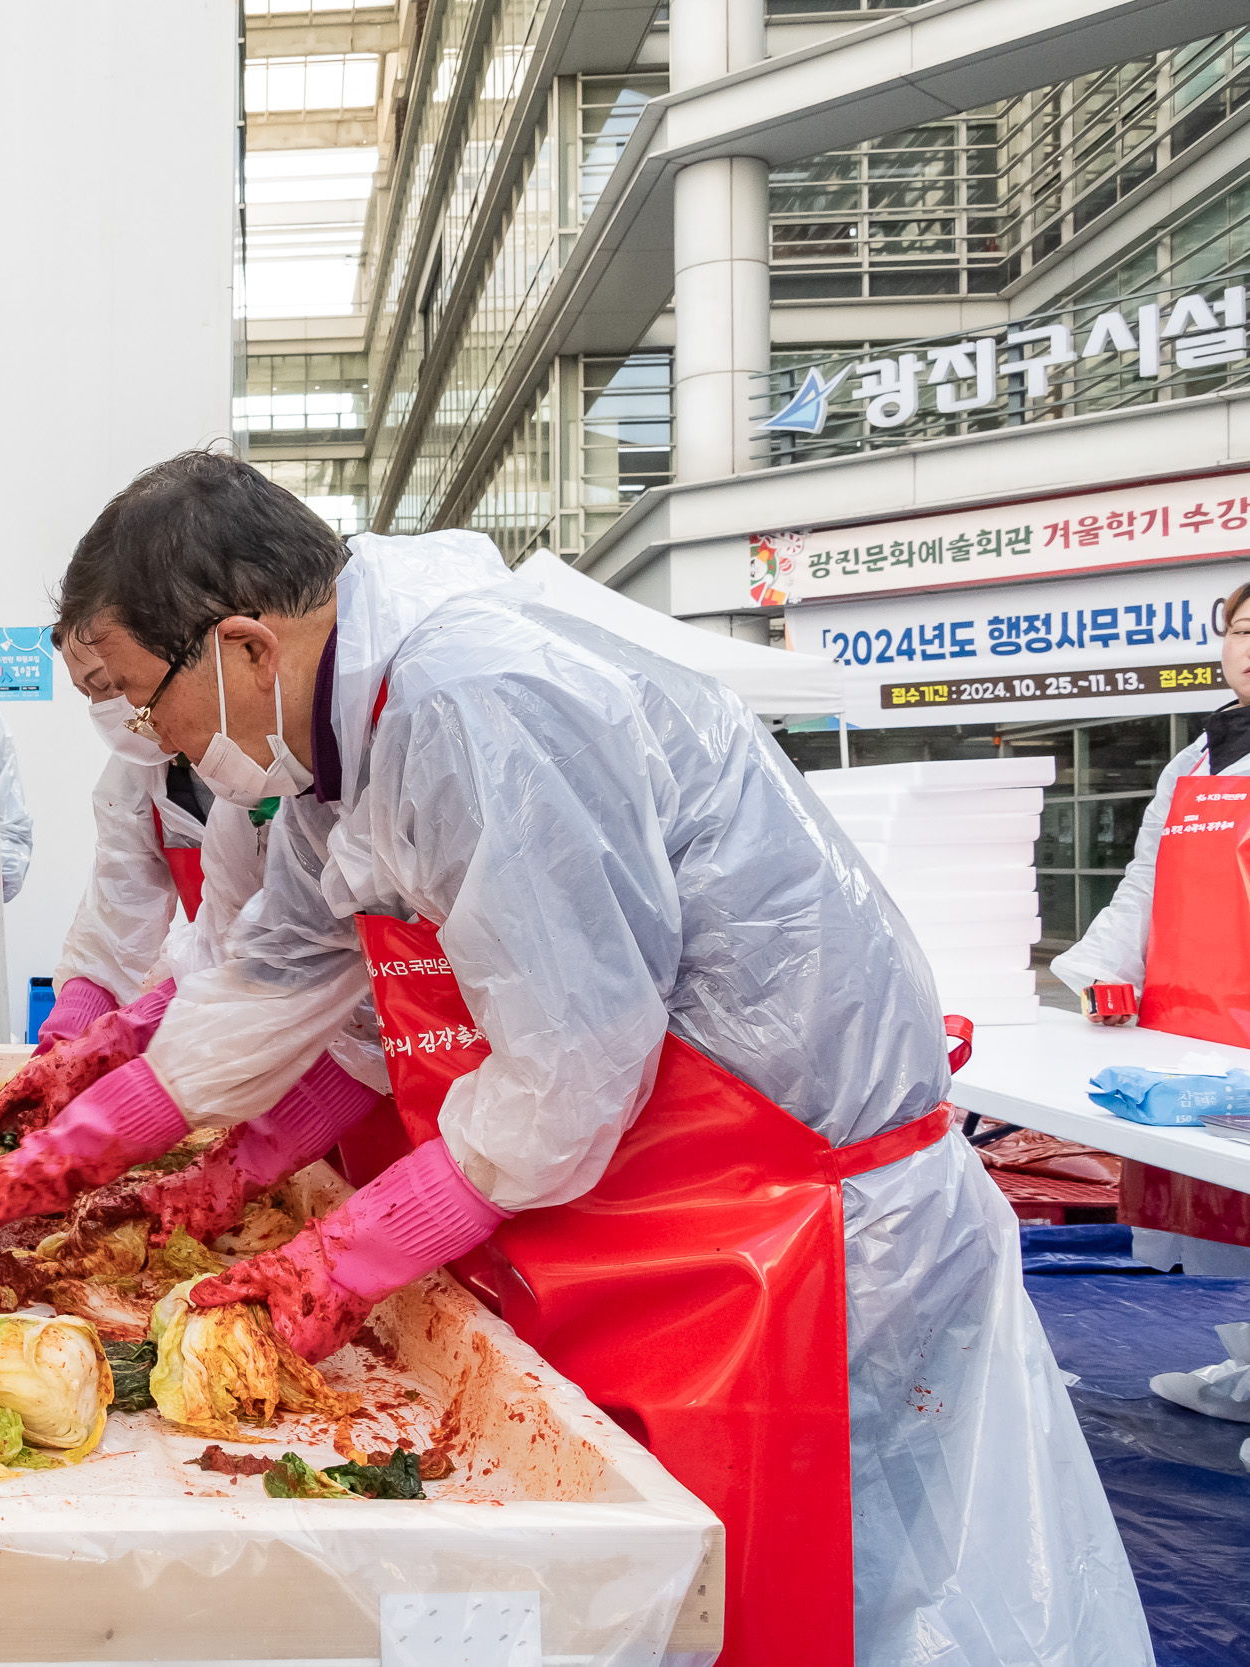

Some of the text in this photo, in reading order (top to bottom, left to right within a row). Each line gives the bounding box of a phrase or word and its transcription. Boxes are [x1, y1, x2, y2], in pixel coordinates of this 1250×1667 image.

[852, 285, 1247, 428] 광진구시설
[809, 496, 1250, 578] 광진문화예술회관 겨울학기 수강
[988, 598, 1226, 656] 행정사무감사」
[1115, 672, 1145, 691] 13.
[382, 1034, 412, 1057] 랑의
[1175, 1115, 1192, 1123] 150
